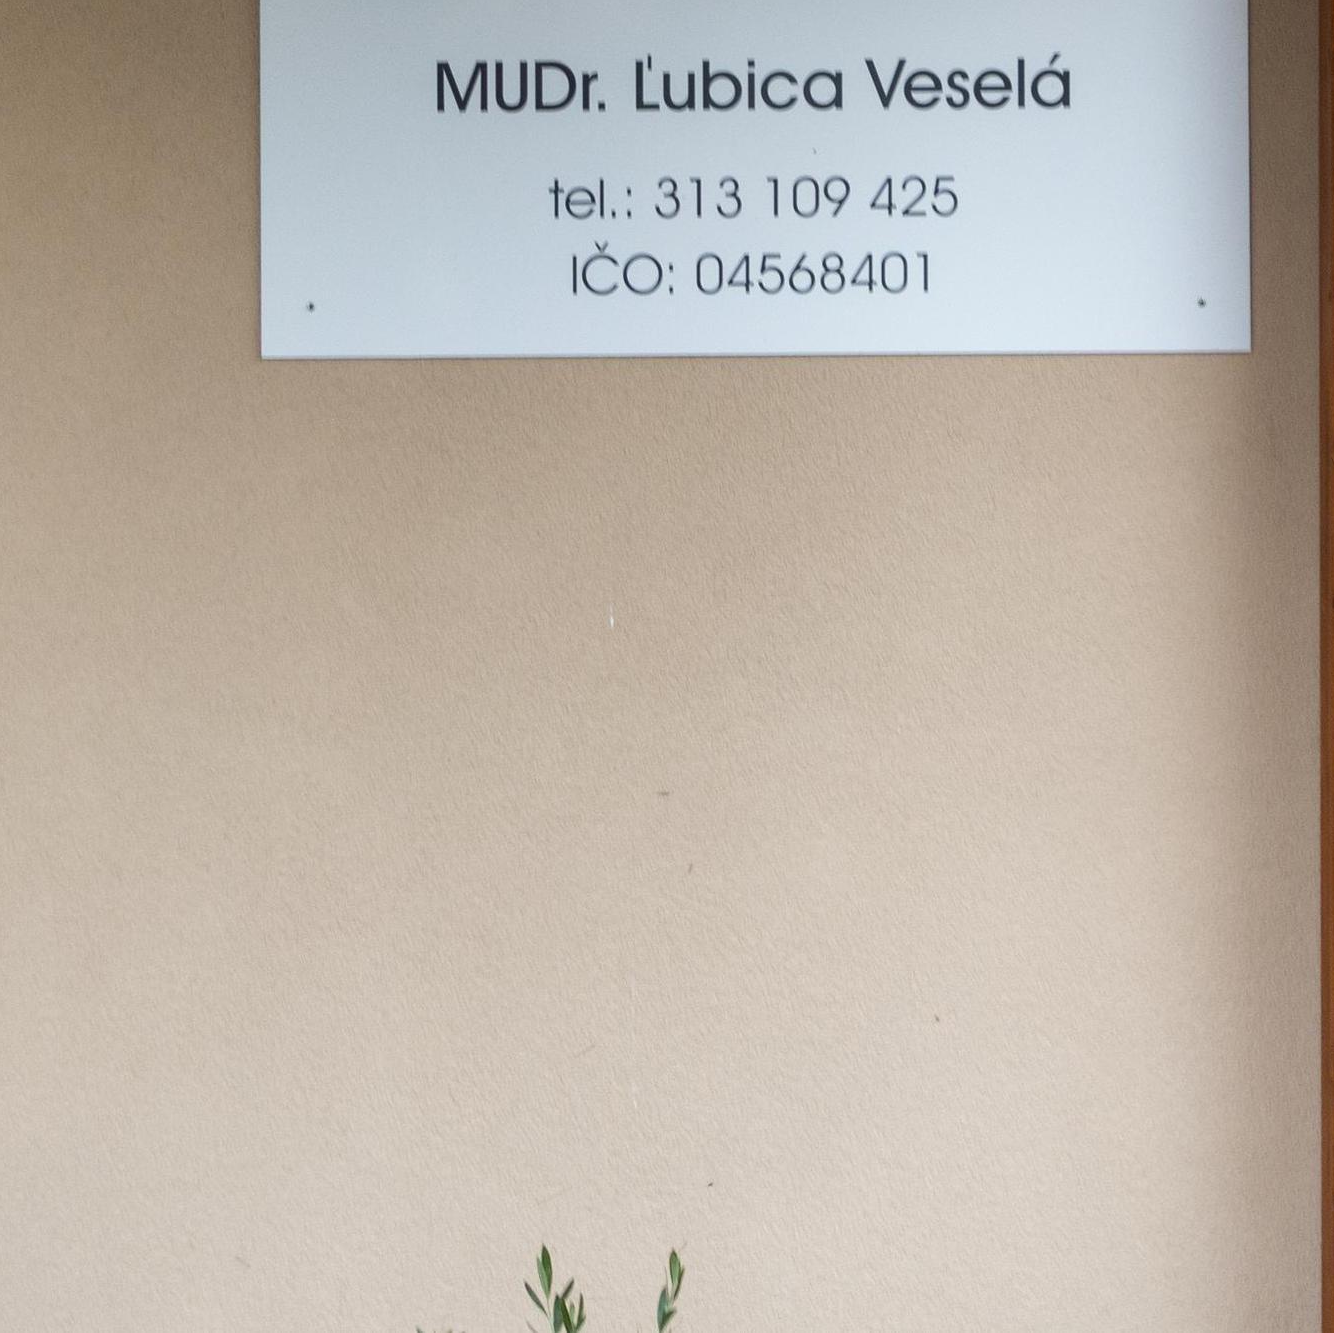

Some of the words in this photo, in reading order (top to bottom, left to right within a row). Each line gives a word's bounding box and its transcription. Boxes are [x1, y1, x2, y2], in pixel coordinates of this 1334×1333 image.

[436, 59, 607, 114] MUDr.
[634, 53, 843, 112] Ľubica
[865, 53, 1072, 110] Veselá
[548, 178, 633, 220] tel.:
[654, 177, 744, 219] 313
[766, 176, 851, 218] 109
[869, 175, 959, 217] 425
[571, 242, 675, 296] IČO:
[696, 252, 931, 295] 04568401
